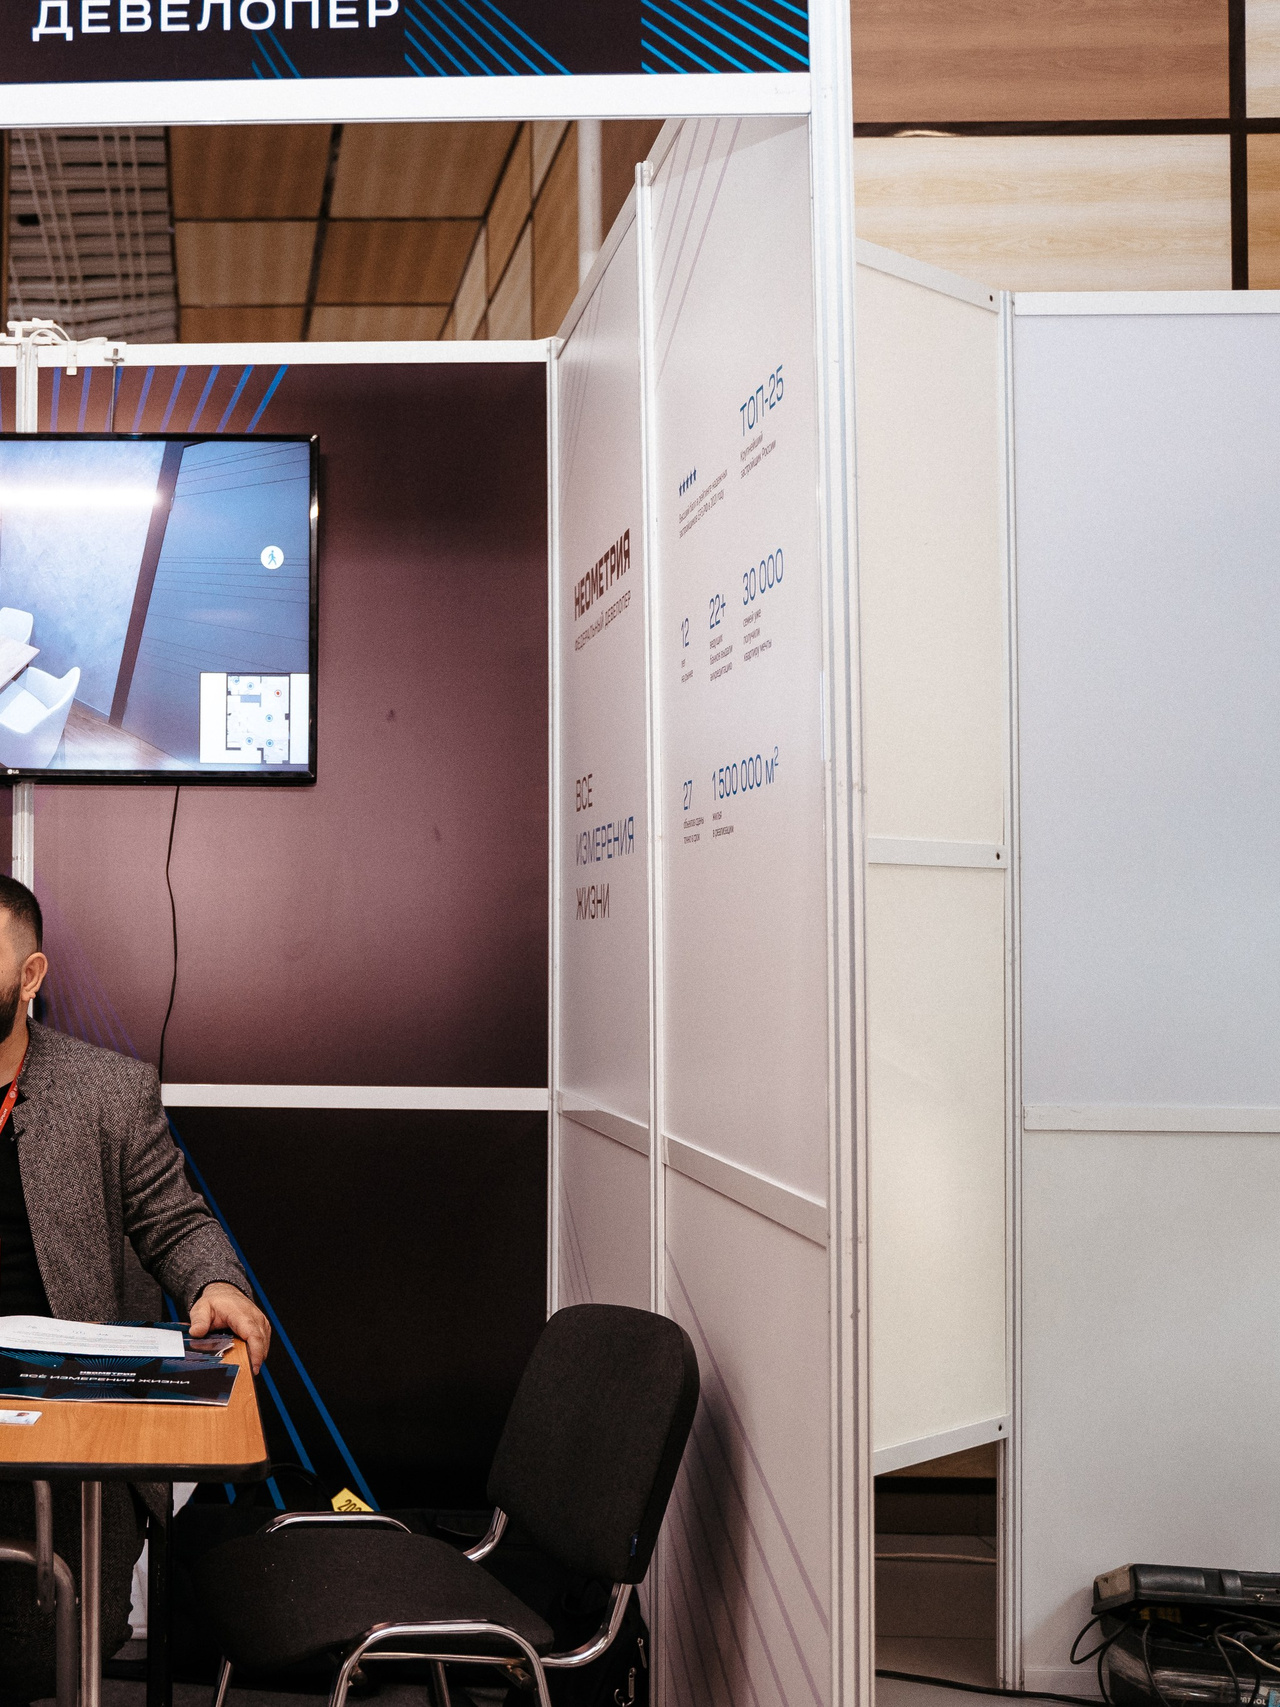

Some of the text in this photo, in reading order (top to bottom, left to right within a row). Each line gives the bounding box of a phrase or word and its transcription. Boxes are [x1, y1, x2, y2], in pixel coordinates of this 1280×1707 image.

[31, 0, 400, 41] ДЕВЕЛОПЕР
[739, 364, 784, 437] ТОП-25
[574, 527, 631, 621] НЕОМЕТРИЯ
[709, 594, 726, 630] 22+
[681, 617, 690, 649] 12
[576, 773, 593, 812] ВСЕ
[682, 779, 693, 811] 27
[576, 816, 635, 866] ИЗМЕРЕНИЯ
[576, 883, 610, 920] ЖИЗНИ
